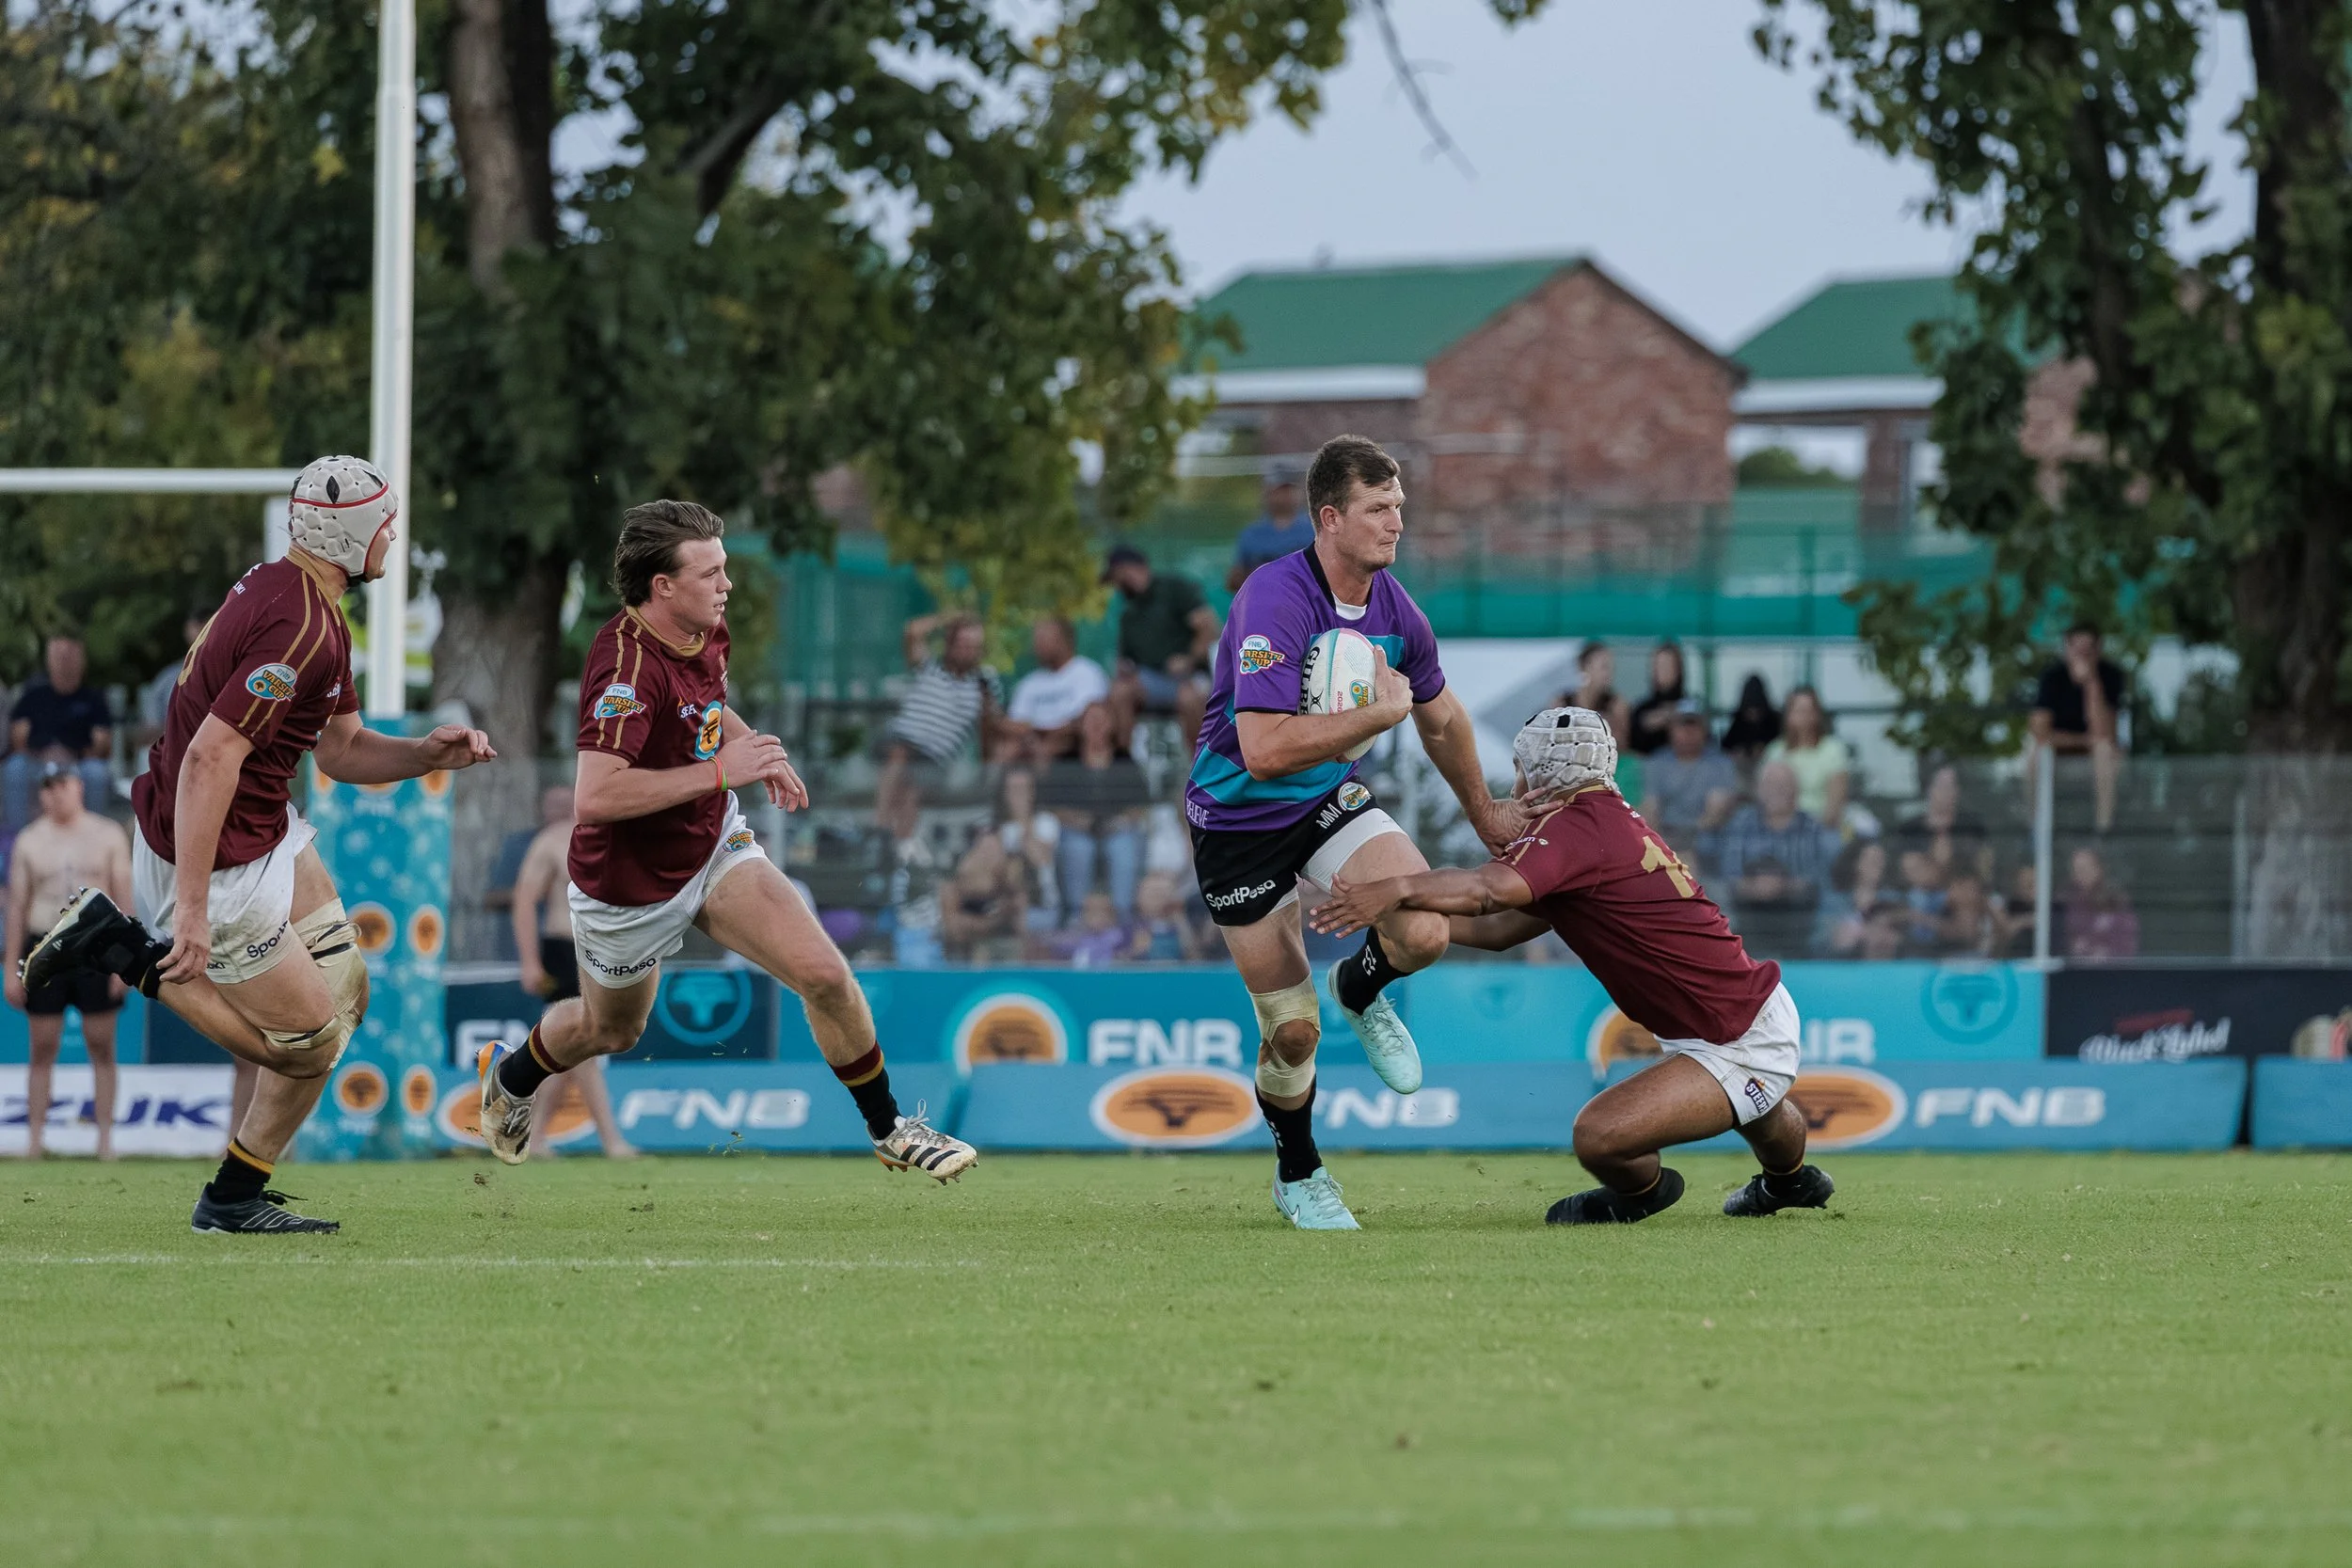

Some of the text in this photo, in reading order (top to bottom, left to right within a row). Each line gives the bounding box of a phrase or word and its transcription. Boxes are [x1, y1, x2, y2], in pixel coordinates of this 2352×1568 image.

[1243, 650, 1283, 662] ARSITY
[277, 668, 291, 681] FNB
[268, 685, 285, 700] CUP
[612, 688, 628, 696] FNB
[1315, 802, 1343, 830] MM
[1205, 879, 1277, 911] SportPesa
[585, 949, 657, 976] SportPesa
[619, 1088, 811, 1130] FNB
[1915, 1086, 2106, 1128] FNB
